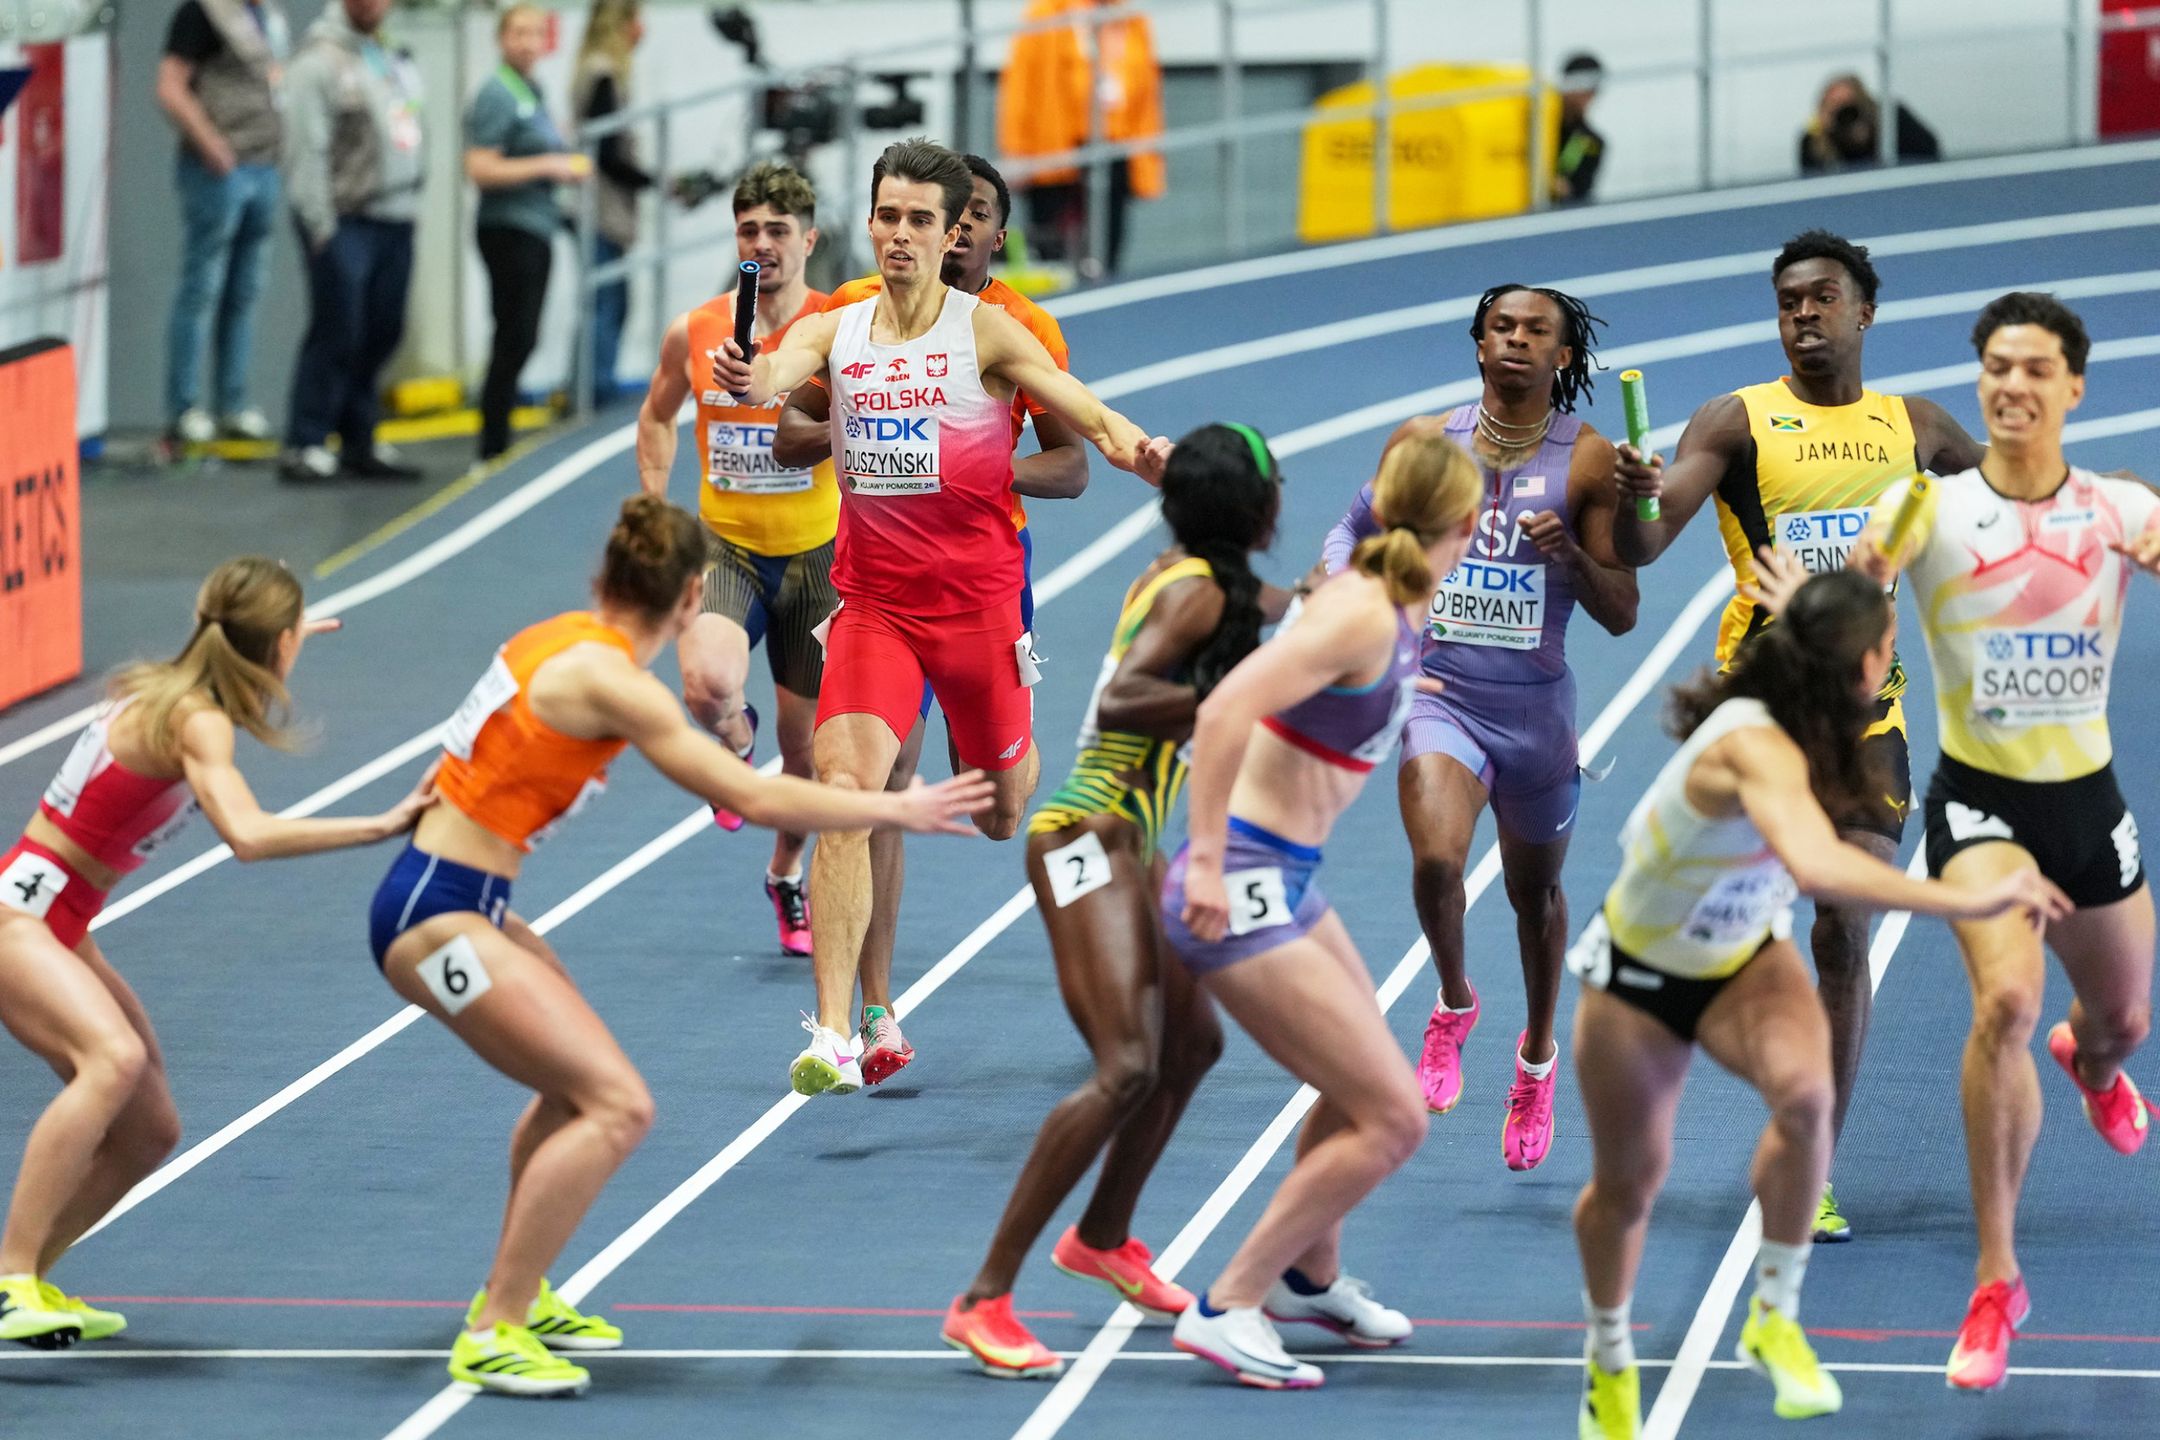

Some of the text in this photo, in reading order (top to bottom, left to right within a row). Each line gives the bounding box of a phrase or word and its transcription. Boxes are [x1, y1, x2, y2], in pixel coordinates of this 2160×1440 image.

[884, 373, 910, 382] ORLEN
[854, 387, 947, 411] POLSKA
[736, 426, 777, 447] TD
[858, 418, 929, 441] TDK
[845, 447, 933, 474] DUSZYŃSKI
[1795, 442, 1889, 464] JAMAICA
[860, 481, 885, 490] KUJAWY
[1460, 562, 1536, 593] TDK
[1431, 589, 1538, 625] O'BRYANT
[2015, 632, 2103, 659] TDK
[1983, 666, 2104, 697] SACOOR
[1066, 856, 1090, 888] 2
[14, 873, 45, 903] 4
[1246, 882, 1269, 920] 5
[443, 954, 469, 996] 6
